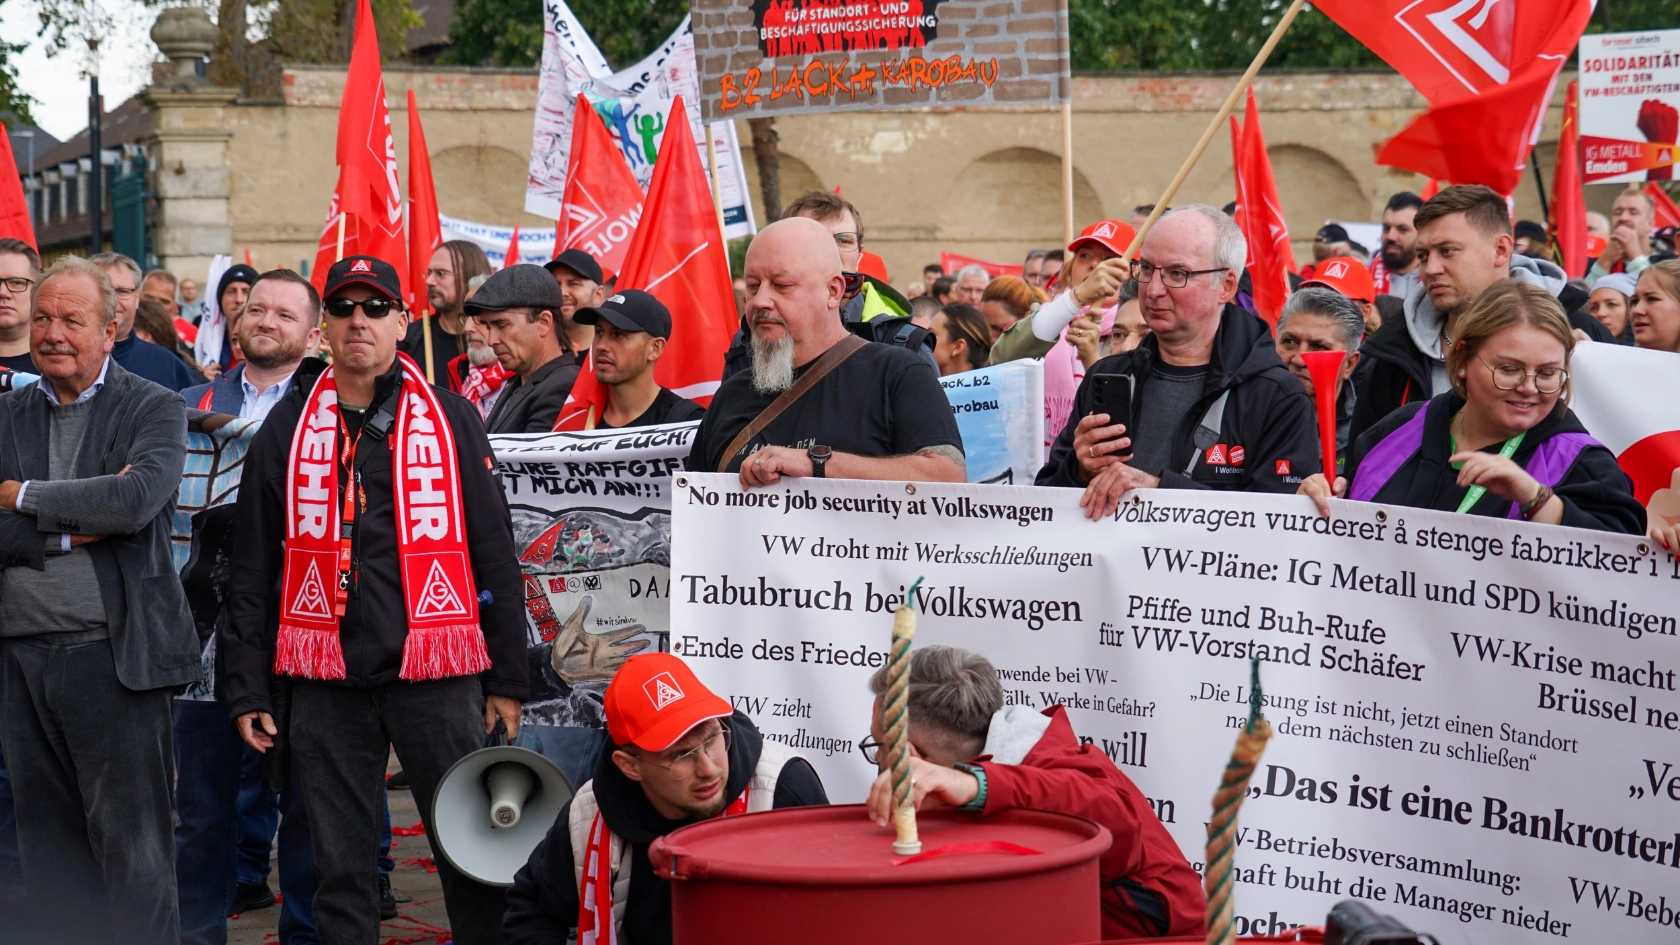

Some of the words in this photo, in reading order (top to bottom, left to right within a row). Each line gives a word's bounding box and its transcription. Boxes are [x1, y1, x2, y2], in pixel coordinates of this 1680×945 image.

[785, 3, 807, 22] FÜR
[809, 4, 870, 20] STANDORT
[880, 2, 909, 16] UND
[1584, 50, 1680, 74] SOLIDARITÄT
[1611, 74, 1629, 84] MIT
[1633, 73, 1652, 82] DEN
[719, 67, 761, 113] B2
[770, 58, 850, 101] LACK
[881, 54, 997, 94] KAROBAU
[1585, 160, 1628, 174] Emden
[1586, 146, 1597, 159] IG
[1599, 144, 1642, 158] METALL
[940, 375, 990, 388] ack_b2
[951, 400, 999, 414] arobau
[559, 440, 612, 452] AUF
[615, 429, 690, 450] EUCH!
[298, 389, 338, 540] MEHR
[407, 391, 449, 542] MEHR
[530, 474, 598, 496] MICH
[603, 480, 661, 498] AN!!!
[688, 486, 720, 506] No
[725, 491, 780, 508] more
[783, 489, 817, 514] job
[822, 494, 902, 520] security
[907, 498, 927, 516] at
[931, 496, 1054, 527] Volkswagen
[761, 534, 806, 555] VW
[810, 536, 870, 560] droht
[875, 542, 909, 561] mit
[915, 542, 1094, 572] Werksschließungen
[1113, 500, 1256, 532] Volkswagen
[1265, 511, 1387, 542] vurderer
[1394, 519, 1408, 544] å
[1416, 526, 1503, 561] stenge
[1510, 534, 1641, 575] fabrikker
[1649, 552, 1658, 577] i
[680, 574, 853, 612] Tabubruch
[864, 582, 905, 614] bei
[916, 586, 1083, 630] Volkswagen
[1142, 546, 1278, 581] VW-Pläne:
[1286, 558, 1322, 586] IG
[1330, 563, 1417, 598] Metall
[1424, 580, 1476, 606] und
[1484, 583, 1540, 614] SPD
[1548, 591, 1677, 640] kündigen
[1127, 594, 1192, 624] Pfiffe
[1201, 606, 1250, 628] und
[1258, 606, 1386, 644] Buh-Rufe
[682, 635, 744, 659] Ende
[752, 639, 794, 662] des
[1099, 622, 1124, 647] für
[1132, 625, 1311, 666] VW-Vorstand
[1320, 644, 1426, 682] Schäfer
[1450, 632, 1583, 676] VW-Krise
[1590, 660, 1676, 692] macht
[1055, 666, 1080, 684] bei
[729, 696, 769, 716] VW
[772, 698, 812, 718] zieht
[1039, 692, 1090, 709] Werke
[1094, 695, 1104, 711] in
[1107, 696, 1156, 718] Gefahr?
[1190, 682, 1230, 702] „Die
[1236, 686, 1309, 716] Lsung
[1314, 696, 1337, 715] ist
[1343, 700, 1395, 726] nicht,
[1400, 708, 1440, 730] jetzt
[1446, 716, 1494, 739] einen
[1500, 723, 1578, 753] Standort
[1537, 682, 1637, 724] Brüssel
[1645, 708, 1680, 732] ne
[1102, 731, 1148, 768] will
[1278, 716, 1322, 738] dem
[1328, 725, 1413, 752] nächsten
[1419, 740, 1440, 756] zu
[1446, 742, 1537, 772] schließen“
[1245, 764, 1338, 804] „Das
[1347, 774, 1393, 812] ist
[1401, 784, 1472, 825] eine
[1284, 867, 1342, 895] buht
[1348, 876, 1386, 901] die
[1393, 882, 1496, 922] Manager
[1502, 906, 1572, 938] nieder
